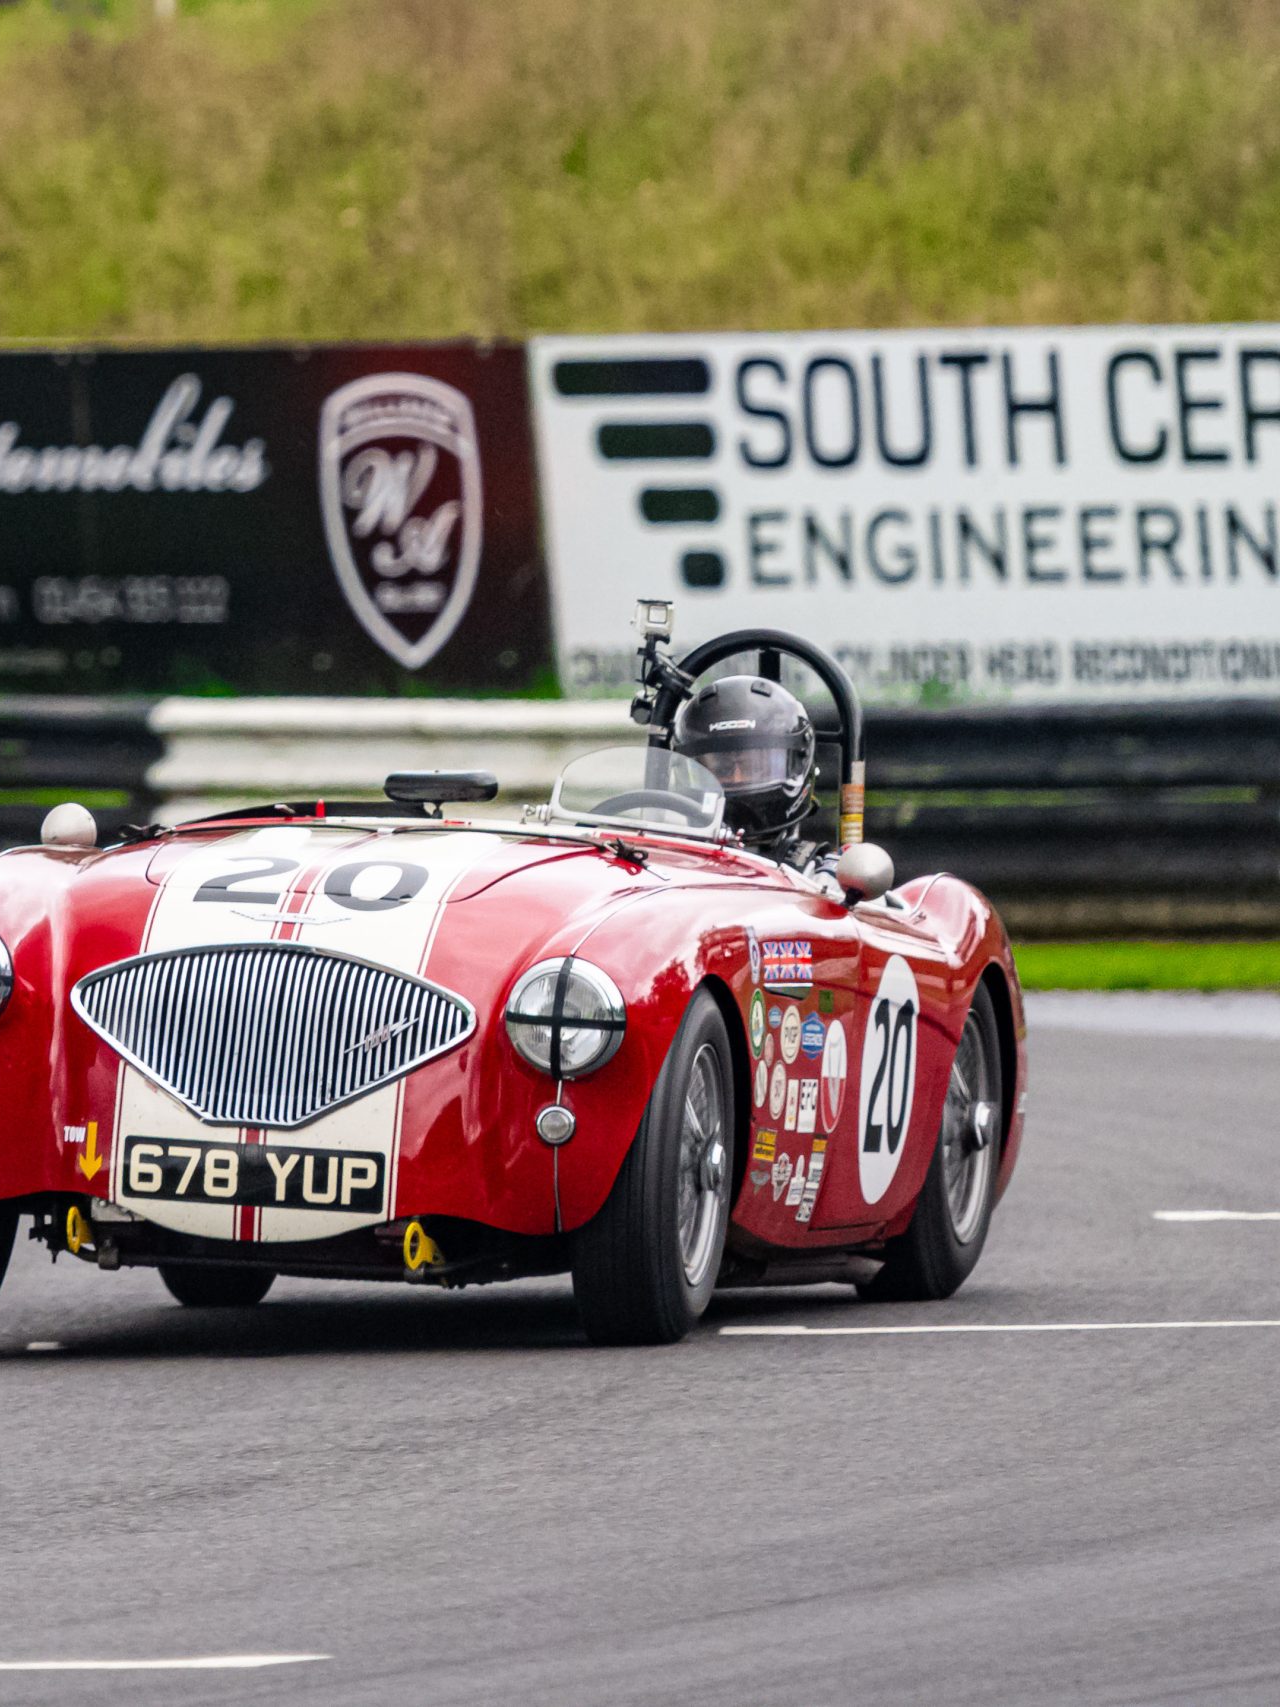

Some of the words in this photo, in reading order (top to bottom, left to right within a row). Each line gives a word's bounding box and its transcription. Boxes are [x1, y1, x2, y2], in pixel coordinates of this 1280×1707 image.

[735, 349, 1068, 470] SOUTH
[746, 500, 1280, 588] ENGINEERIN
[193, 855, 430, 912] 20
[862, 997, 915, 1154] 20
[63, 1125, 87, 1143] TOW
[128, 1143, 240, 1198] 678
[266, 1152, 378, 1206] YUP
